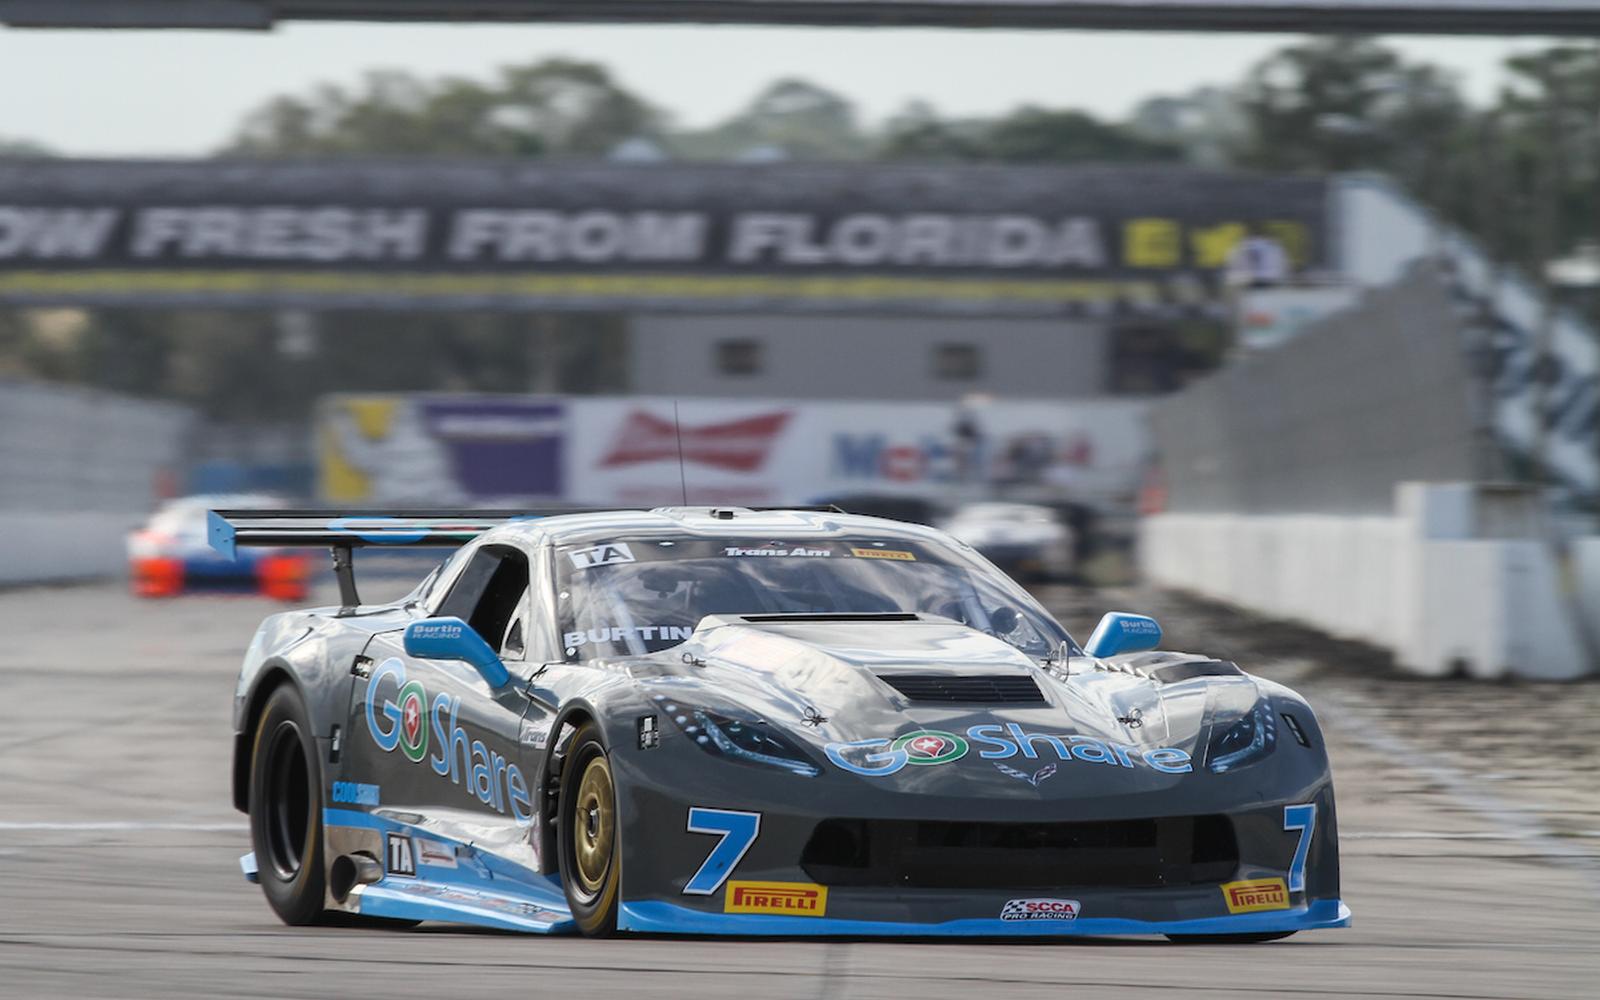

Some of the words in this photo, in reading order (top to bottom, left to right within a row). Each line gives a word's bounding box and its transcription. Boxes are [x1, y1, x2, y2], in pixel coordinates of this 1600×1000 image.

[130, 206, 428, 260] FRESH
[449, 208, 707, 262] FROM
[728, 211, 1106, 266] FLORIDA
[573, 546, 632, 565] TA
[725, 547, 789, 557] Trans
[790, 547, 831, 557] Am
[414, 625, 462, 633] Burtin
[1120, 621, 1155, 629] Burtin
[564, 626, 693, 648] BURTIN
[388, 835, 414, 872] TA
[683, 806, 761, 895] 7
[1284, 803, 1316, 892] 7
[733, 887, 818, 909] PIRELLI
[1229, 884, 1284, 907] PIRELLI
[1004, 912, 1028, 920] PRO
[1030, 912, 1074, 920] RACING
[1026, 902, 1074, 913] SCCA
